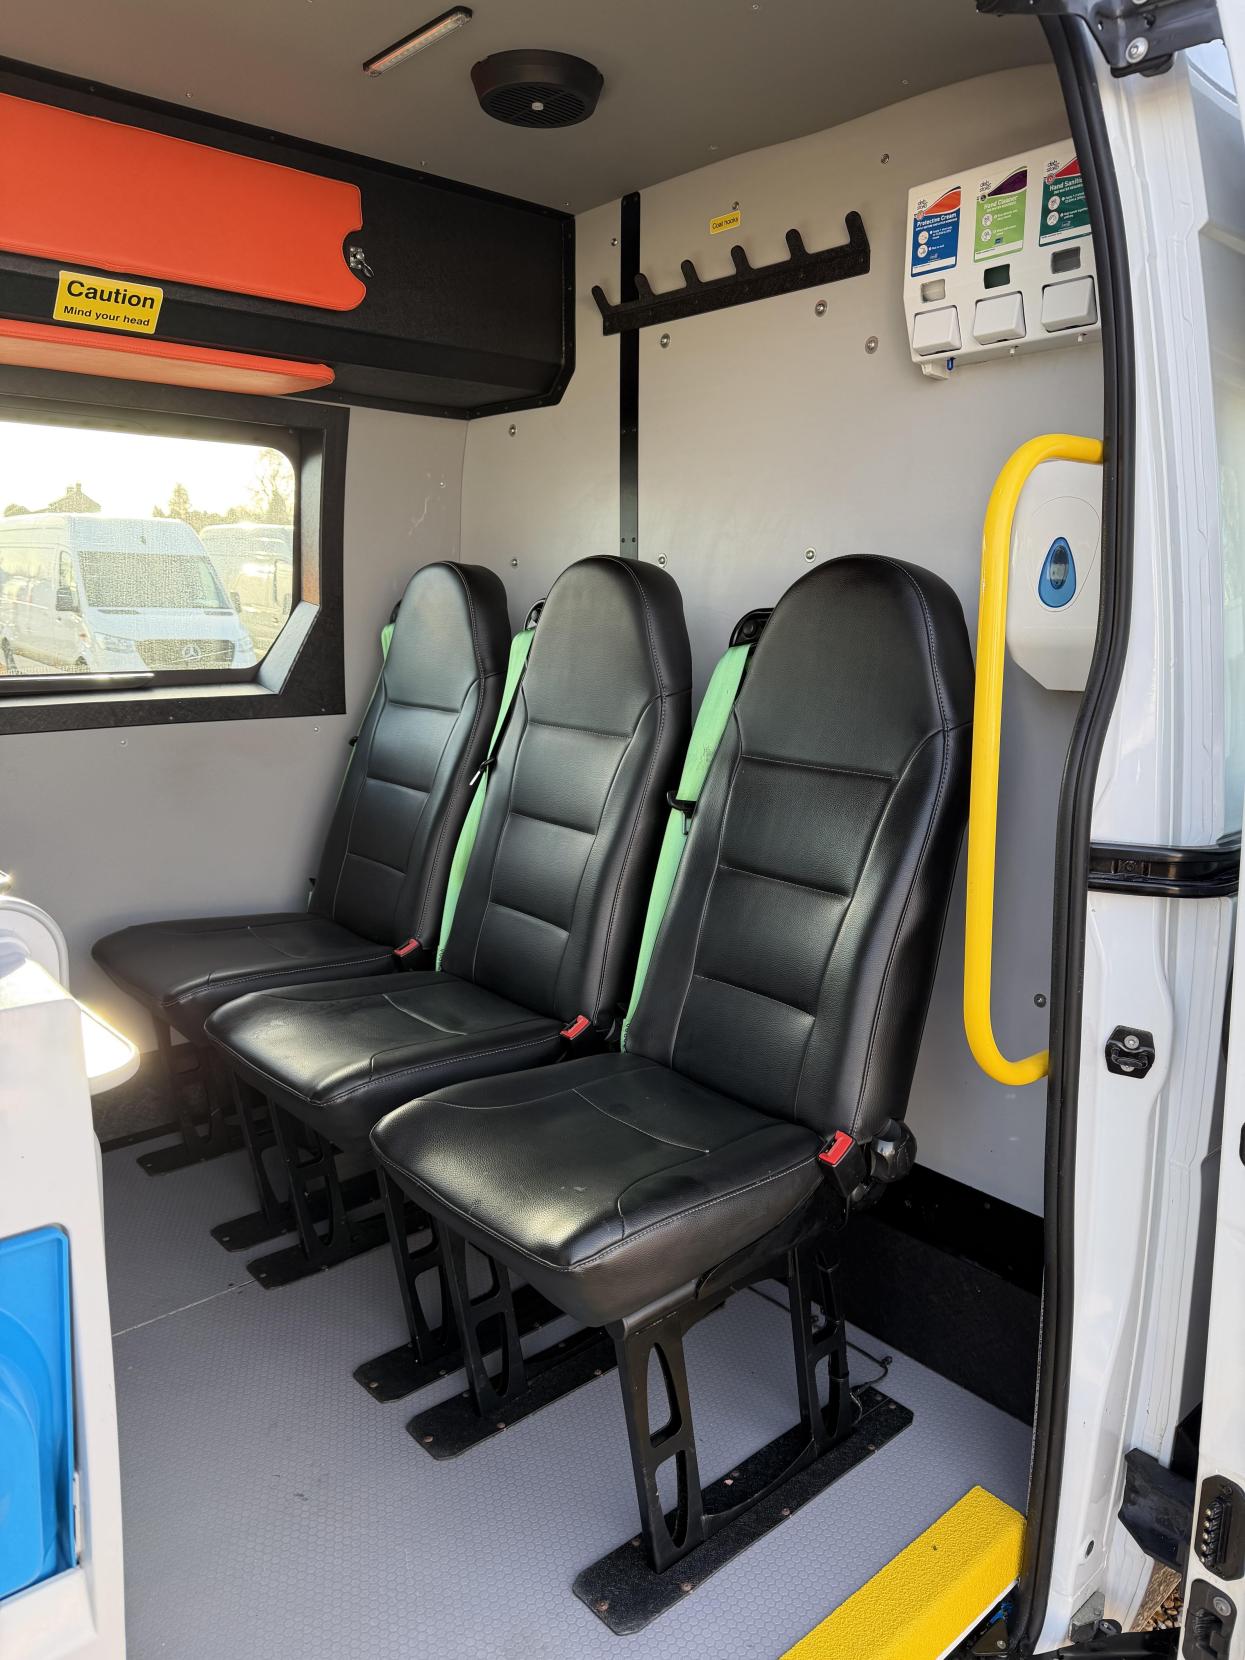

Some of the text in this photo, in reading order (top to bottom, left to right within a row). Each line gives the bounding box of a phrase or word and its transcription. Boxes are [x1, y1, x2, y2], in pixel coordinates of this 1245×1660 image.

[1049, 181, 1064, 192] Hand
[712, 221, 724, 230] Coat
[916, 216, 941, 227] Protective
[940, 213, 957, 221] Cream
[67, 280, 155, 309] Caution
[63, 305, 150, 326] Mind your head
